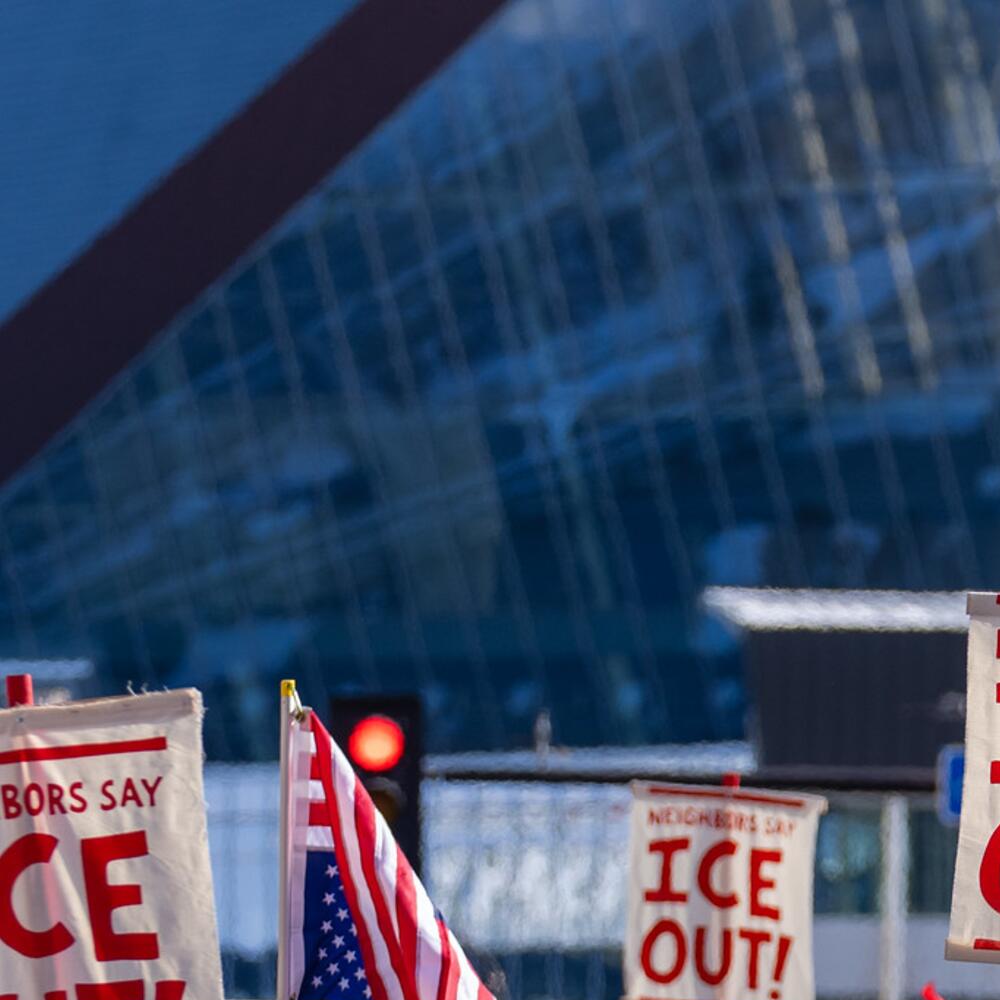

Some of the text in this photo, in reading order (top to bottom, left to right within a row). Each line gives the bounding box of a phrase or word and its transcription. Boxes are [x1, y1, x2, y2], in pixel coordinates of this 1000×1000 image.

[100, 776, 163, 811] SAY
[649, 805, 797, 837] NEIGHBORS SAY
[0, 830, 160, 962] CE
[644, 837, 782, 920] ICE
[641, 918, 791, 1000] OUT!
